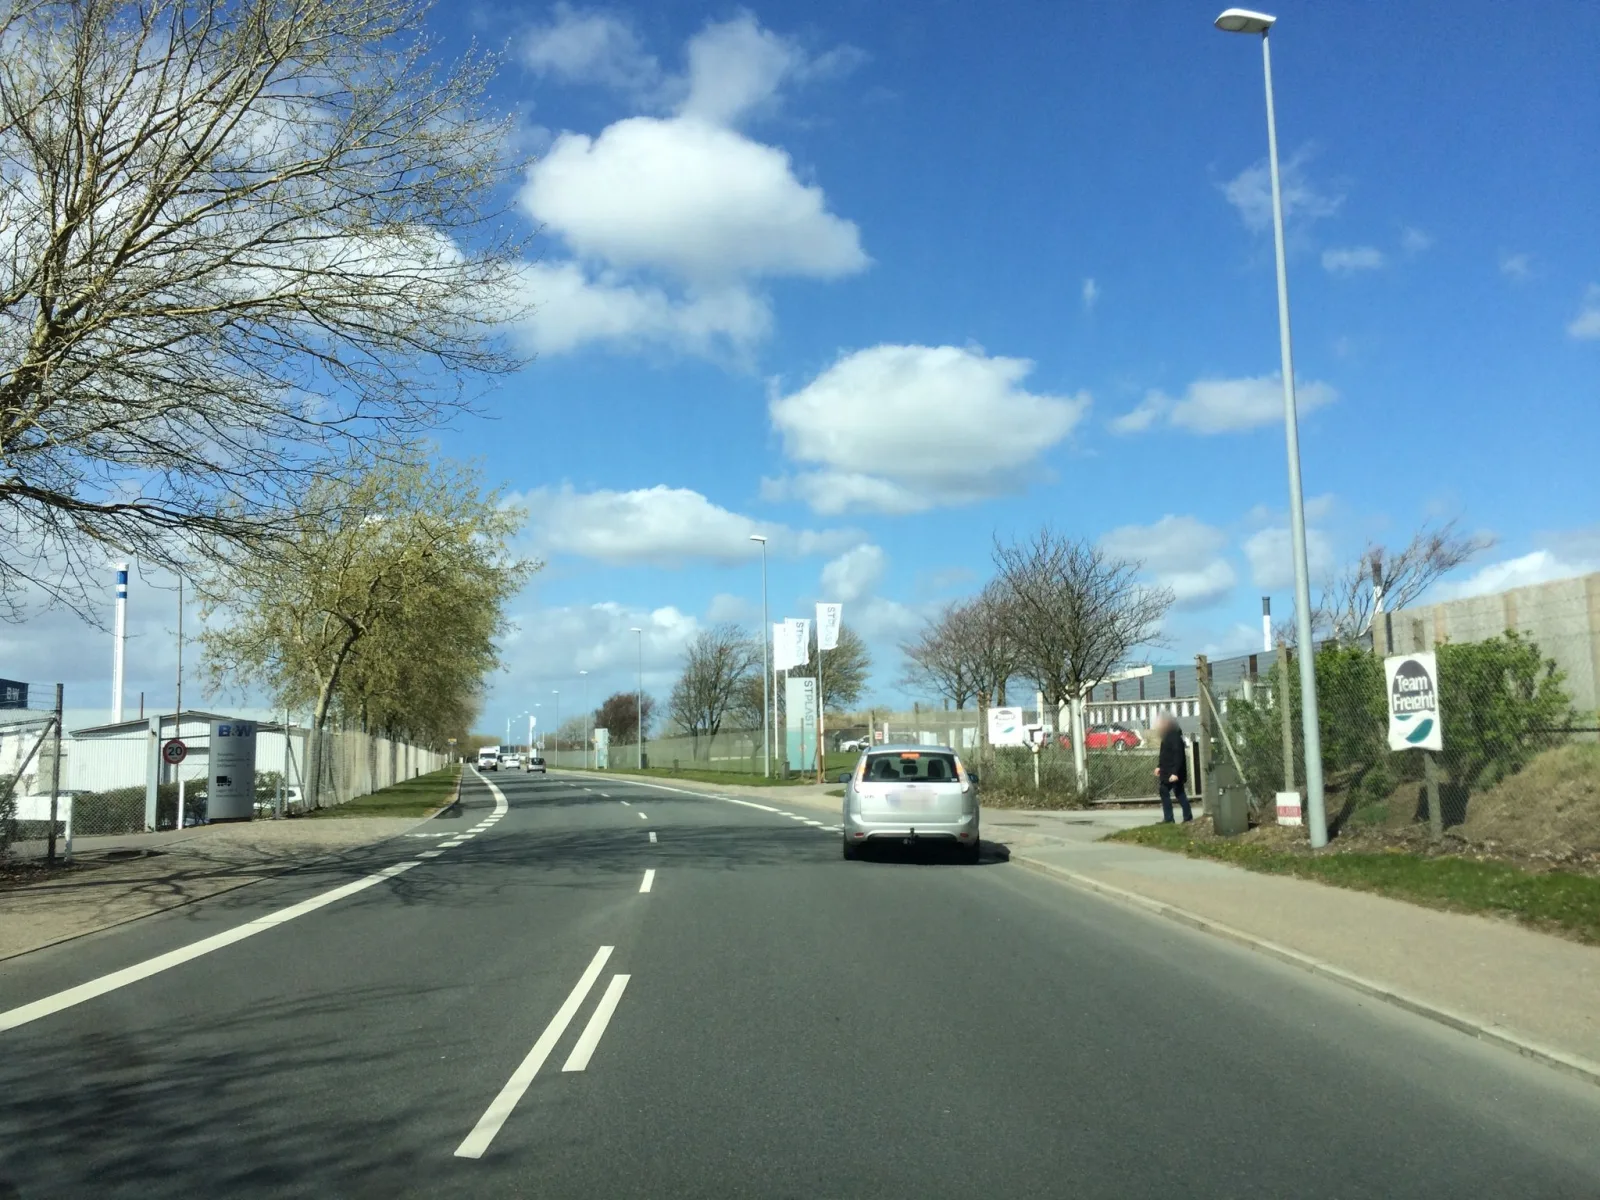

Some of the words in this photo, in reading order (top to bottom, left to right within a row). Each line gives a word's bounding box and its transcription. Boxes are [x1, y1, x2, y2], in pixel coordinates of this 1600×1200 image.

[1395, 674, 1428, 692] Team
[804, 680, 814, 728] STPLAST
[1393, 692, 1436, 711] Freight
[218, 724, 252, 737] B&W
[168, 746, 183, 756] 20
